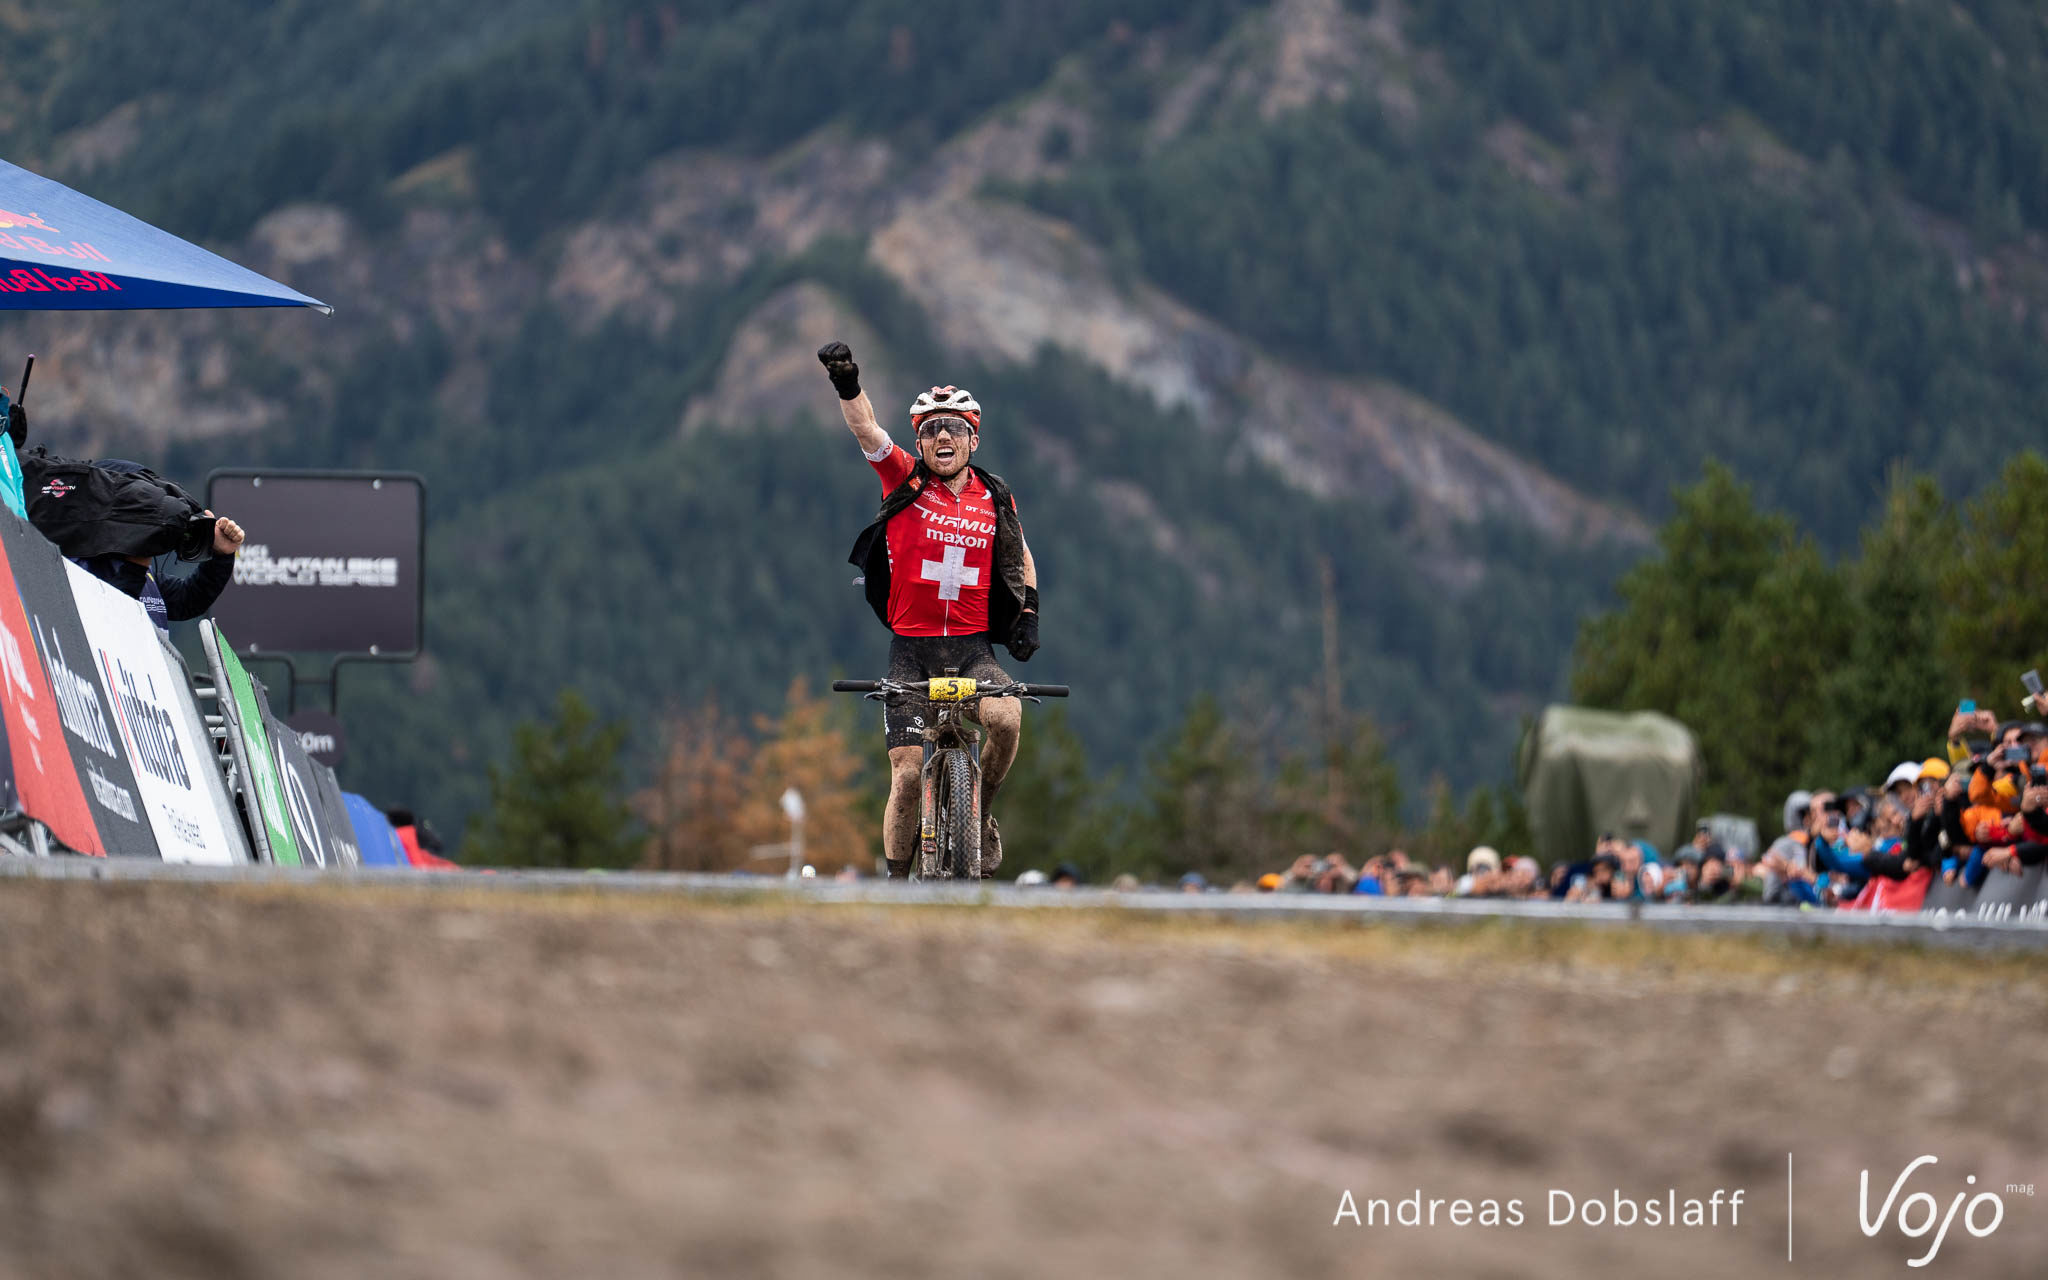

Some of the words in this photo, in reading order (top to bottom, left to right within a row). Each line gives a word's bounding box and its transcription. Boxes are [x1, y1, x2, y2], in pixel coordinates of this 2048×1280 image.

[18, 235, 113, 262] Bull
[965, 505, 979, 513] DT
[926, 527, 988, 550] maxon
[947, 680, 959, 696] 5
